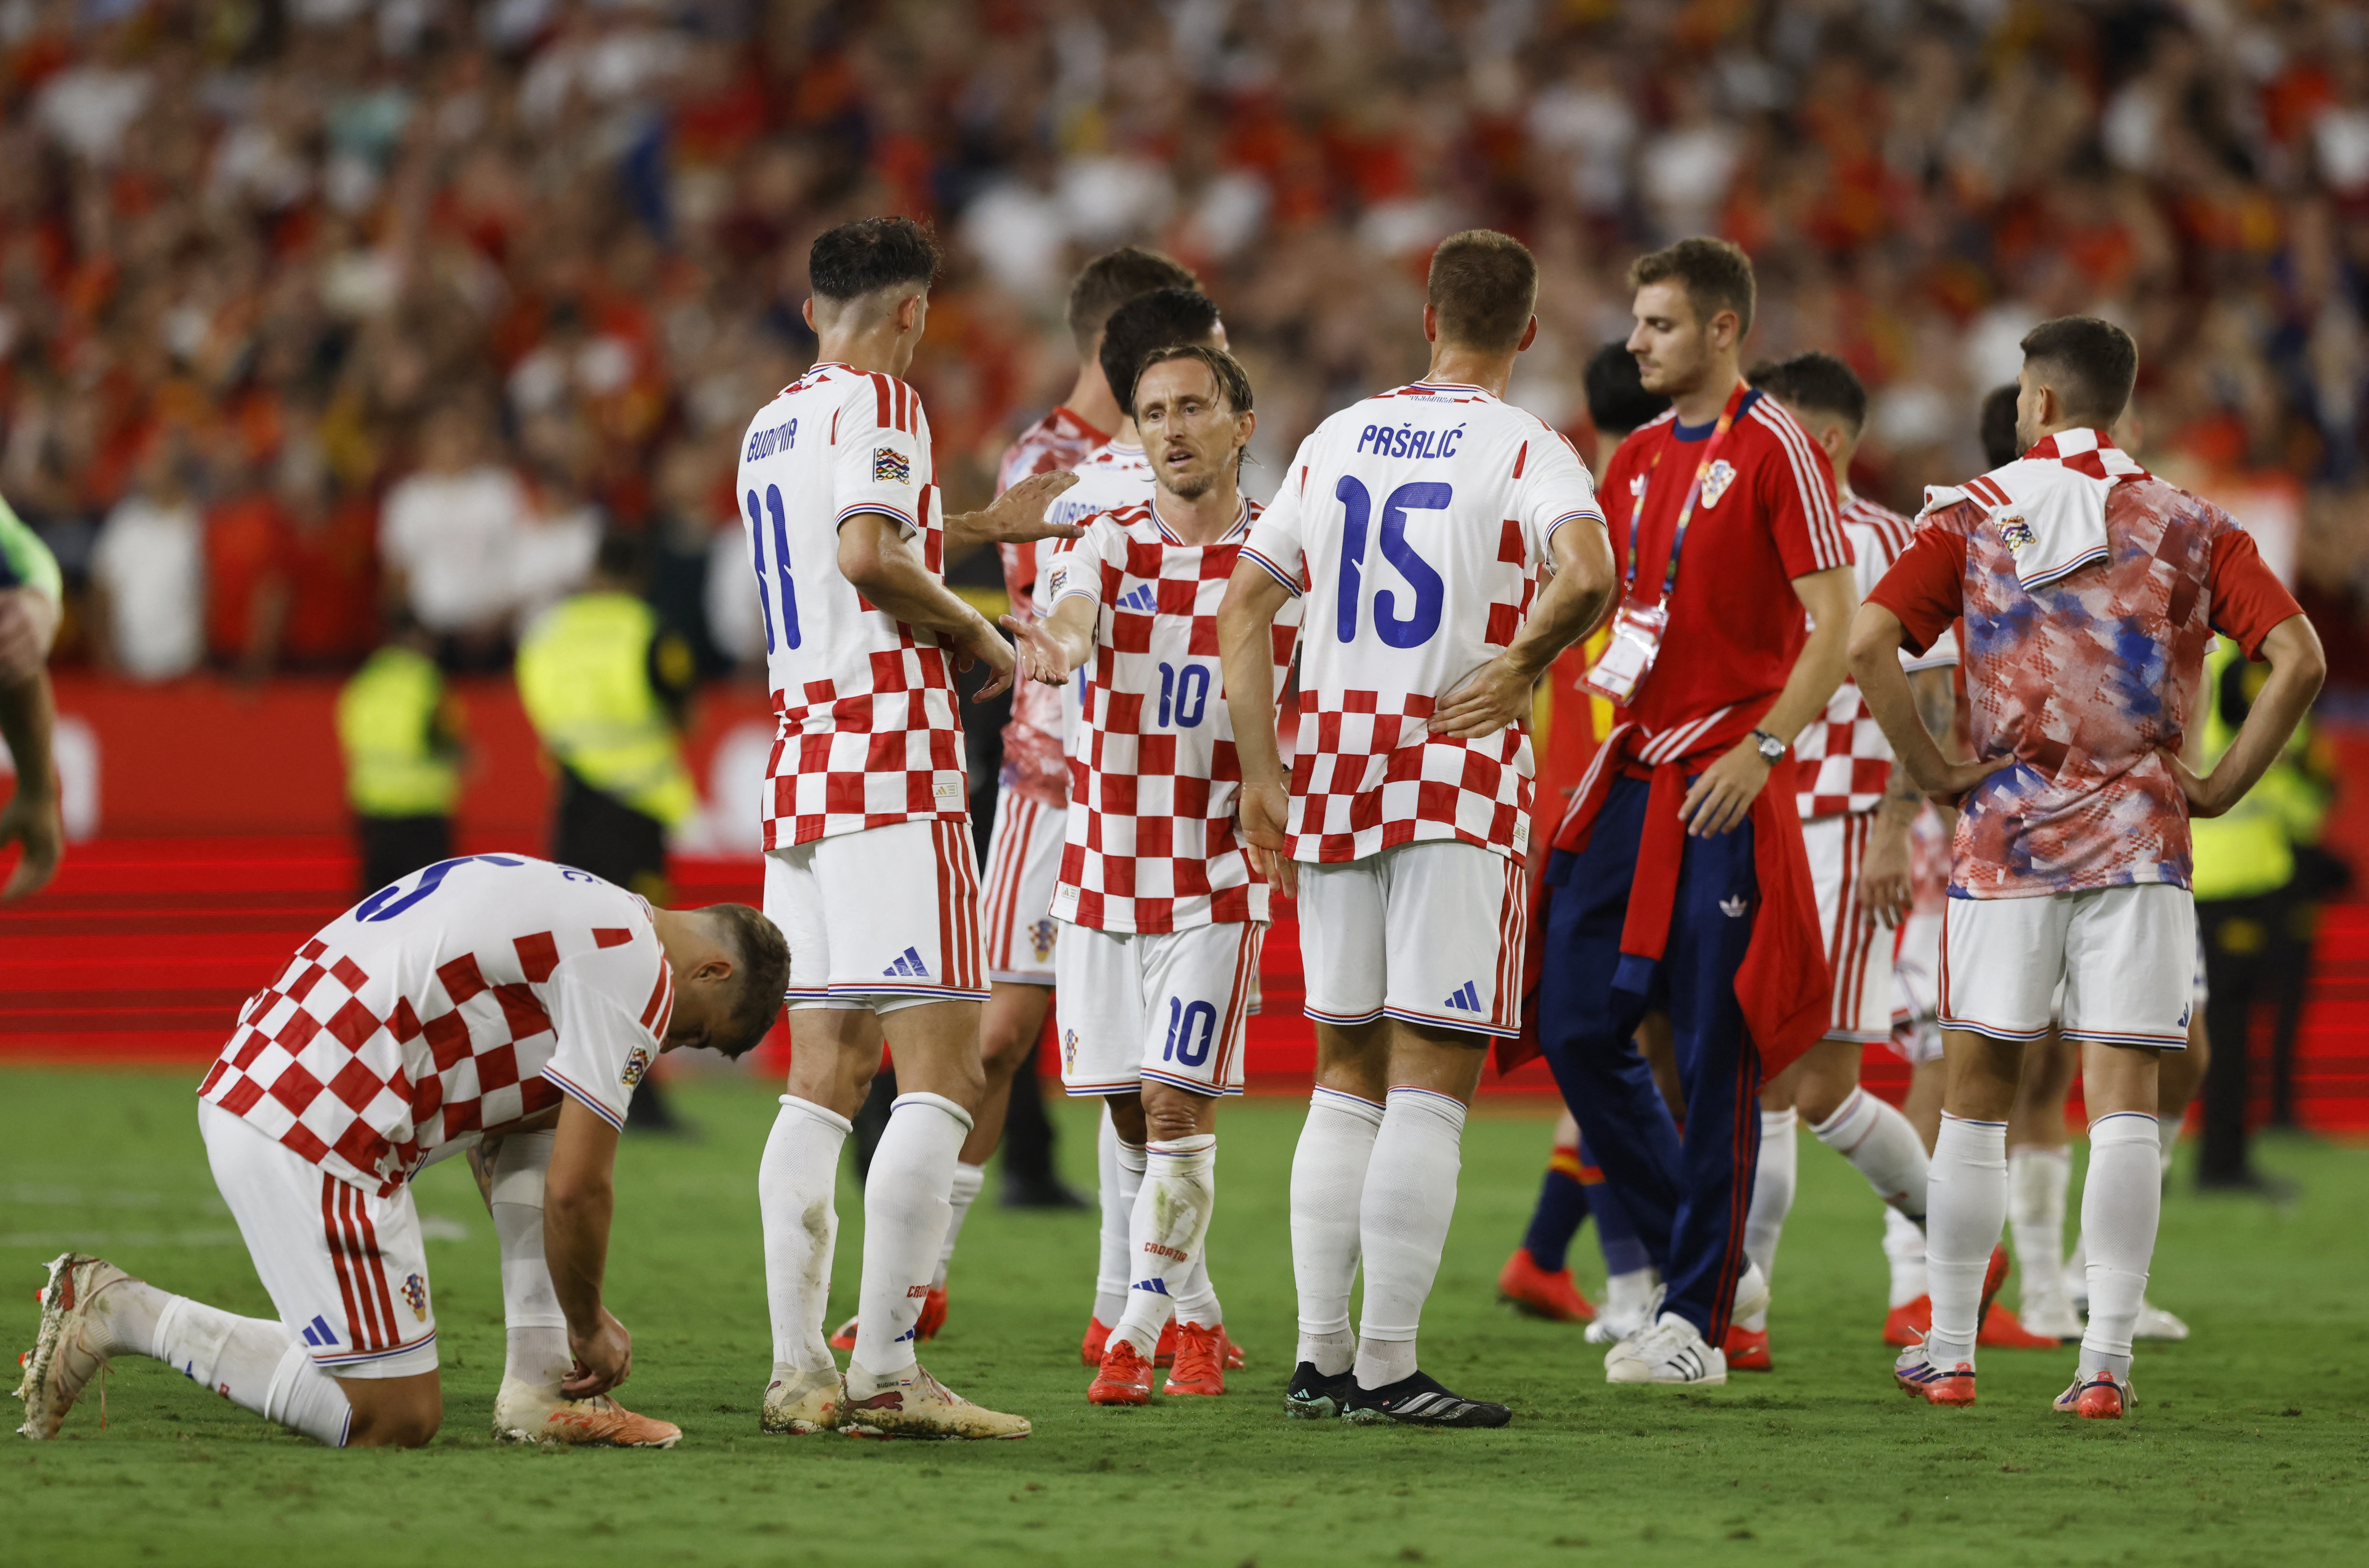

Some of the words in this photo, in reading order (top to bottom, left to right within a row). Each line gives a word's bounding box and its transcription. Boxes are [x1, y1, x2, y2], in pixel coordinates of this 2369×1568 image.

[747, 418, 798, 462] BUDIMIR
[1357, 422, 1464, 459] PAŠALIĆ
[747, 483, 801, 655] 11
[1335, 475, 1453, 649] 15
[1158, 661, 1210, 728] 10
[1163, 996, 1217, 1067] 10
[1144, 1242, 1188, 1263] CROATIA
[1391, 1396, 1410, 1409] PREDATOR
